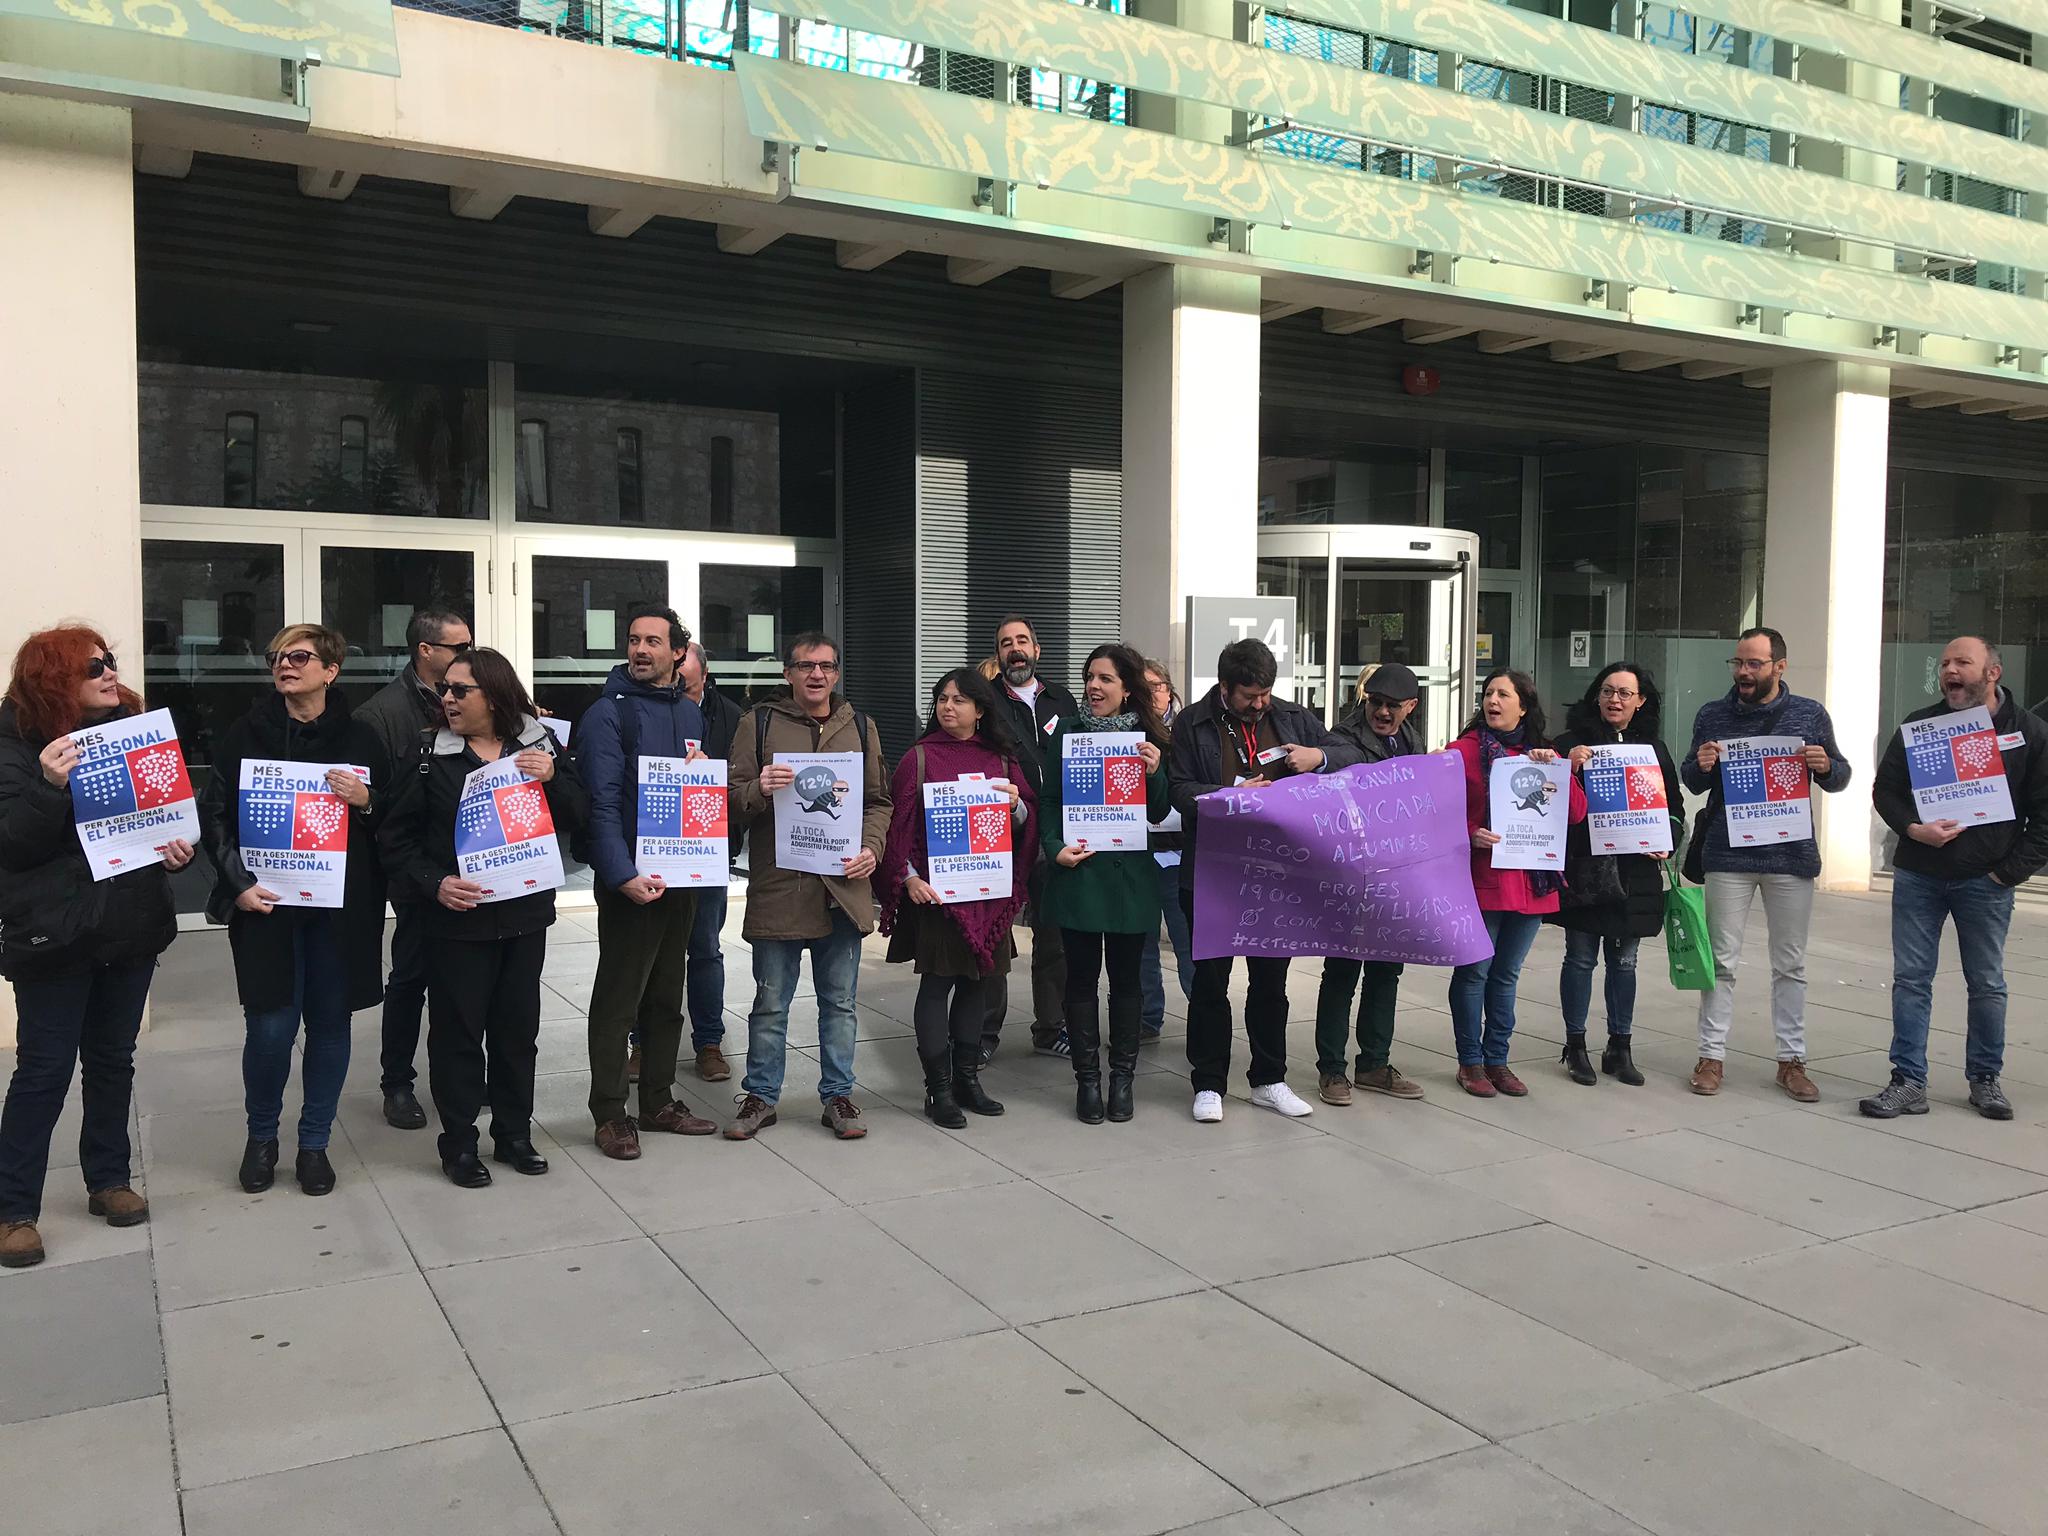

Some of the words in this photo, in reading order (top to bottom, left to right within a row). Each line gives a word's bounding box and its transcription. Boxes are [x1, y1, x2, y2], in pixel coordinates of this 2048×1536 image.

[1229, 617, 1288, 662] T4
[1911, 722, 1935, 735] MÉS
[1913, 721, 1984, 744] PERSONAL
[74, 732, 104, 749] MÉS
[77, 729, 166, 762] PERSONAL
[1071, 736, 1093, 746] MÉS
[1727, 740, 1750, 751] MÉS
[1072, 746, 1137, 757] PERSONAL
[1592, 747, 1612, 758] MÉS
[1728, 747, 1795, 760] PERSONAL
[648, 760, 671, 772] MÉS
[1592, 756, 1652, 768] PERSONAL
[253, 763, 282, 776] MÉS
[252, 776, 334, 792] PERSONA
[466, 770, 530, 797] PERSONAL
[469, 771, 485, 784] MÉS
[648, 772, 718, 785] PERSONAL
[800, 773, 832, 790] 12%
[1515, 774, 1542, 788] 12%
[932, 784, 955, 795] MÉS
[1941, 781, 1980, 792] GESTIONAR
[934, 793, 1001, 806] PERSONAL
[1921, 795, 1935, 805] EL
[1938, 785, 1998, 801] PERSONAL
[1225, 792, 1265, 816] IES
[1751, 802, 1787, 810] GESTIONAR
[84, 821, 102, 831] PER
[114, 808, 164, 824] GESTIONAR
[1084, 813, 1137, 821] PERSONAL
[1312, 792, 1437, 836] MONCADA
[1732, 812, 1745, 820] EL
[1747, 807, 1800, 818] PERSONAL
[87, 828, 105, 842] EL
[108, 811, 184, 836] PERSONAL
[1594, 820, 1606, 828] EL
[1609, 817, 1661, 828] PERSONAL
[790, 825, 802, 835] JA
[802, 826, 826, 837] TOCA
[1517, 825, 1534, 834] TOCA
[790, 834, 822, 844] RECUPERAR
[246, 850, 262, 858] PER
[270, 851, 316, 859] GESTIONAR
[464, 855, 480, 864] PER
[488, 842, 531, 858] GESTIONAR
[643, 846, 656, 855] EL
[658, 846, 718, 855] PERSONAL
[823, 844, 844, 852] PERDUT
[1332, 834, 1429, 863] ALUMNES
[247, 857, 262, 868] EL
[264, 858, 333, 871] PERSONAL
[466, 862, 482, 874] EL
[484, 846, 548, 870] PERSONAL
[935, 865, 947, 873] EL
[950, 861, 1003, 872] PERSONAL
[1244, 864, 1286, 882] 130
[1319, 880, 1401, 900] PROFES
